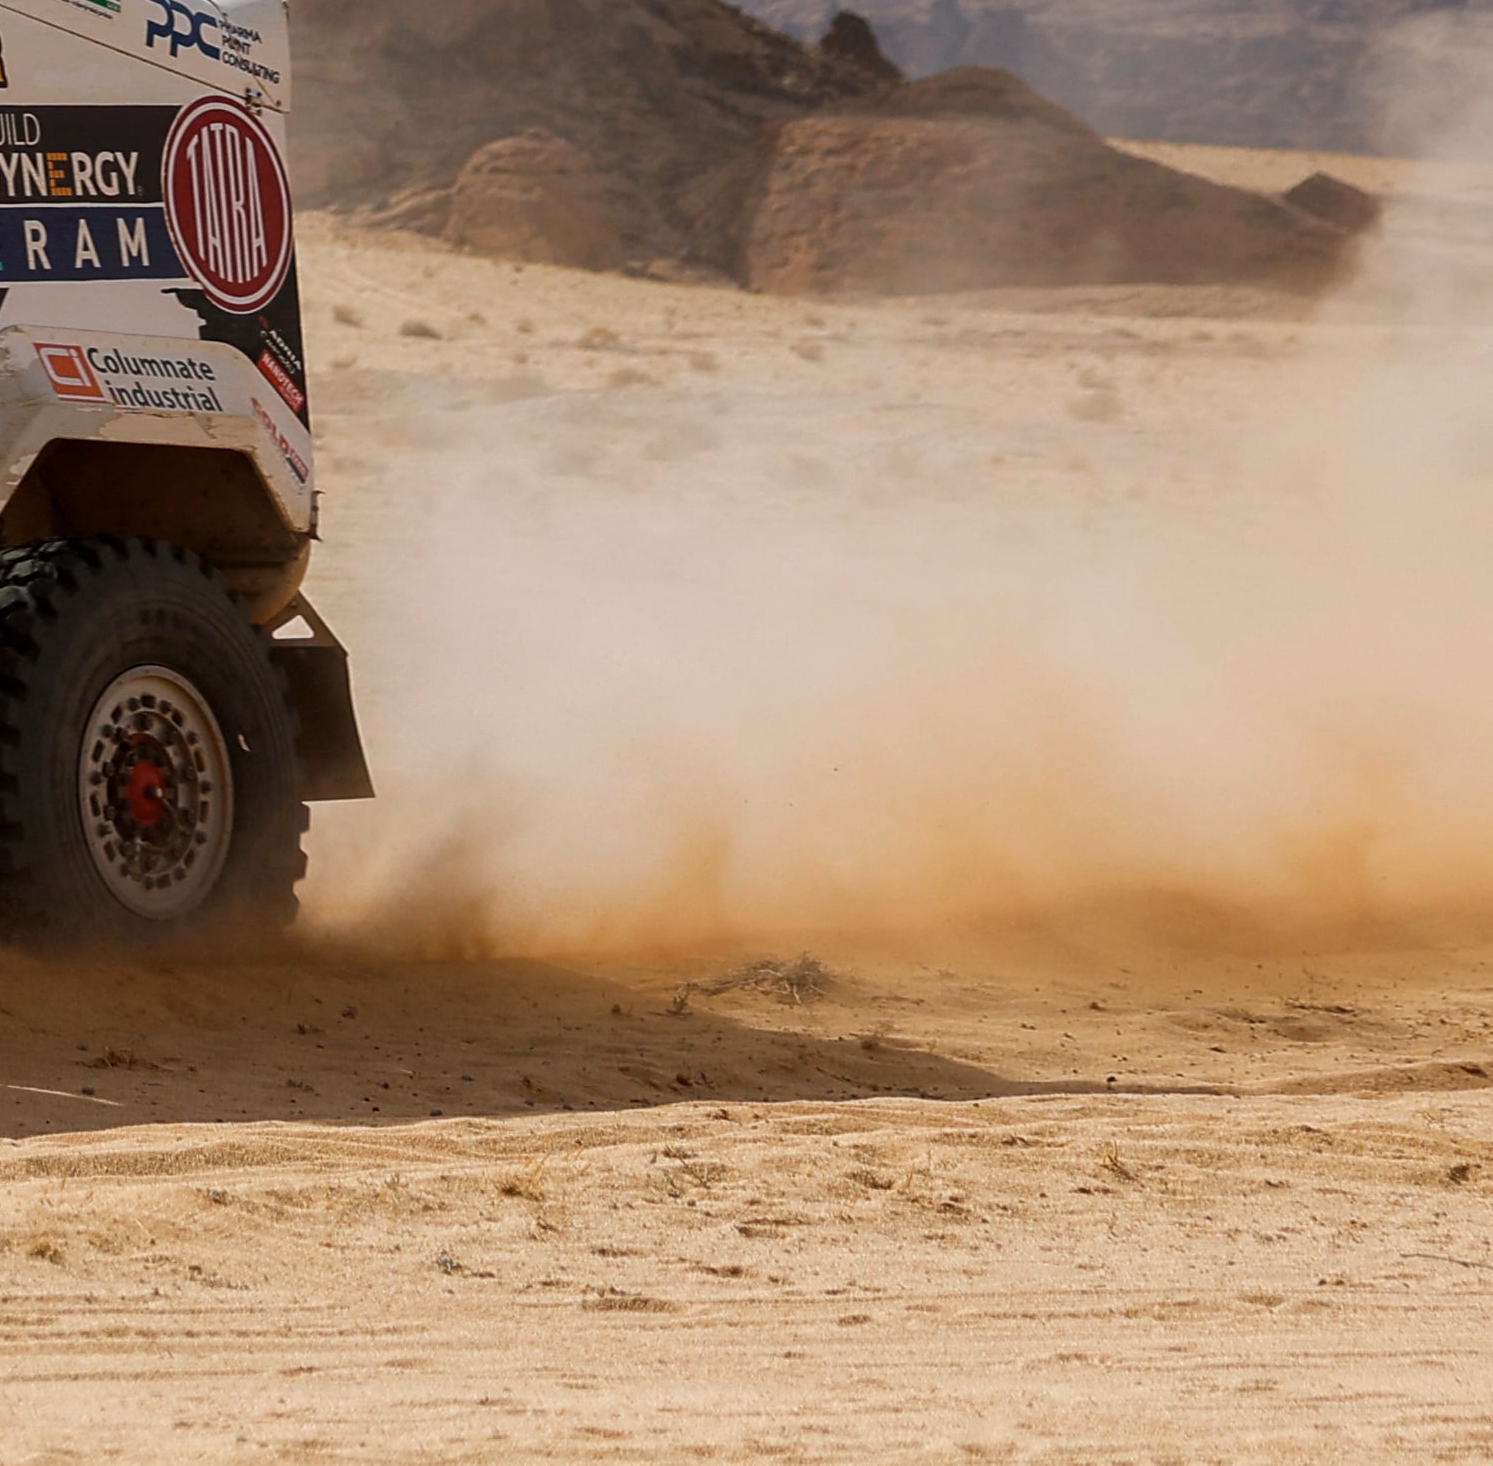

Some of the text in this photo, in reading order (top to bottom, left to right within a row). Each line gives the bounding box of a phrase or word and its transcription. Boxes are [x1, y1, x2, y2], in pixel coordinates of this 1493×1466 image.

[186, 123, 268, 284] TATRA
[87, 347, 216, 382] Columnate
[106, 381, 224, 413] industrial
